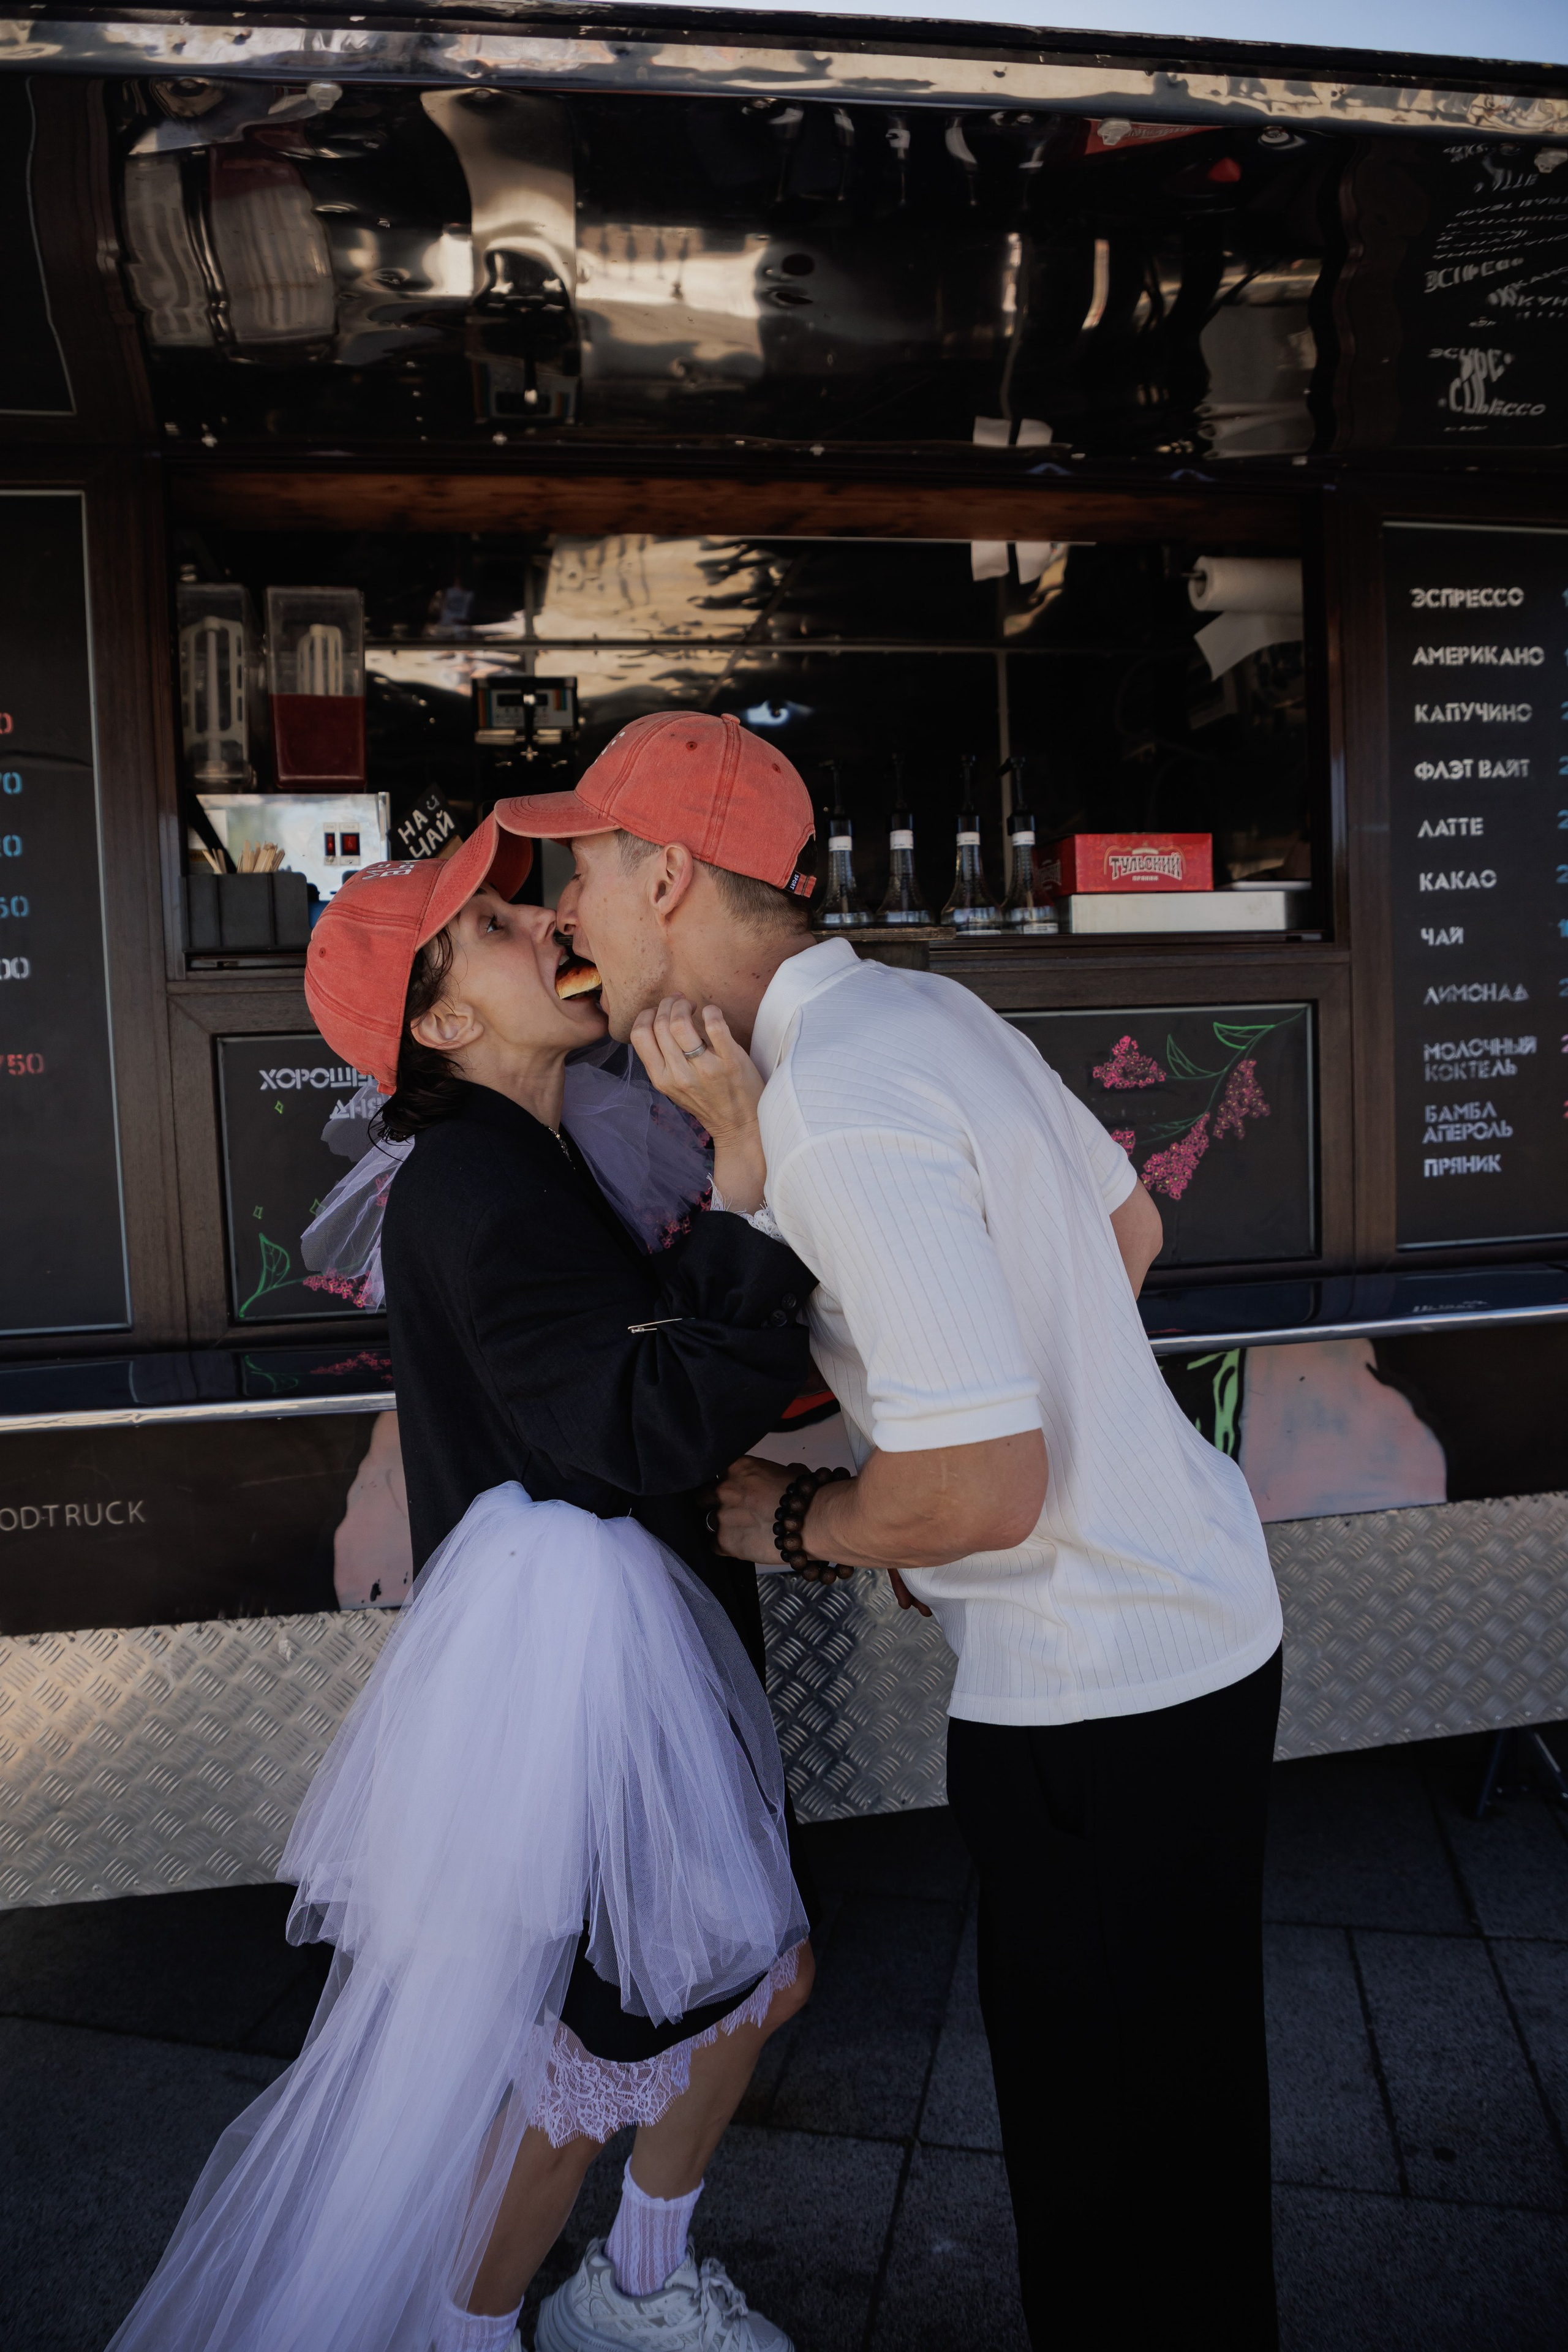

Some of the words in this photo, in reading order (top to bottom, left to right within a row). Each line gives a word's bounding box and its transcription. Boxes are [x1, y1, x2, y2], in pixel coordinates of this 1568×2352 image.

[1411, 587, 1525, 608] ЭСПРЕССО
[1412, 646, 1545, 666] АМЕРИКАНО
[1414, 702, 1532, 723] КАПУЧИНО
[1414, 759, 1474, 781] ФЛЭТ
[398, 809, 428, 844] НА
[409, 810, 454, 858] ЧАЙ
[1417, 818, 1484, 838] ЛАТТЕ
[1109, 852, 1182, 880] ТУЛЬСКИЙ
[790, 875, 799, 890] SPORT
[1419, 869, 1498, 892] КАКАО
[1420, 926, 1464, 946] ЧАЙ
[1423, 982, 1529, 1005] ЛИМОНАД
[1423, 1036, 1537, 1062] МОЛОЧНЫЙ
[259, 1068, 372, 1090] ХОРОШЕ
[1424, 1058, 1518, 1082] КОКТЕЛЬ
[1425, 1101, 1498, 1123] БАМБЛ
[1422, 1120, 1514, 1144] АПЕРОЛЬ
[1423, 1154, 1502, 1177] ПРЯНИК
